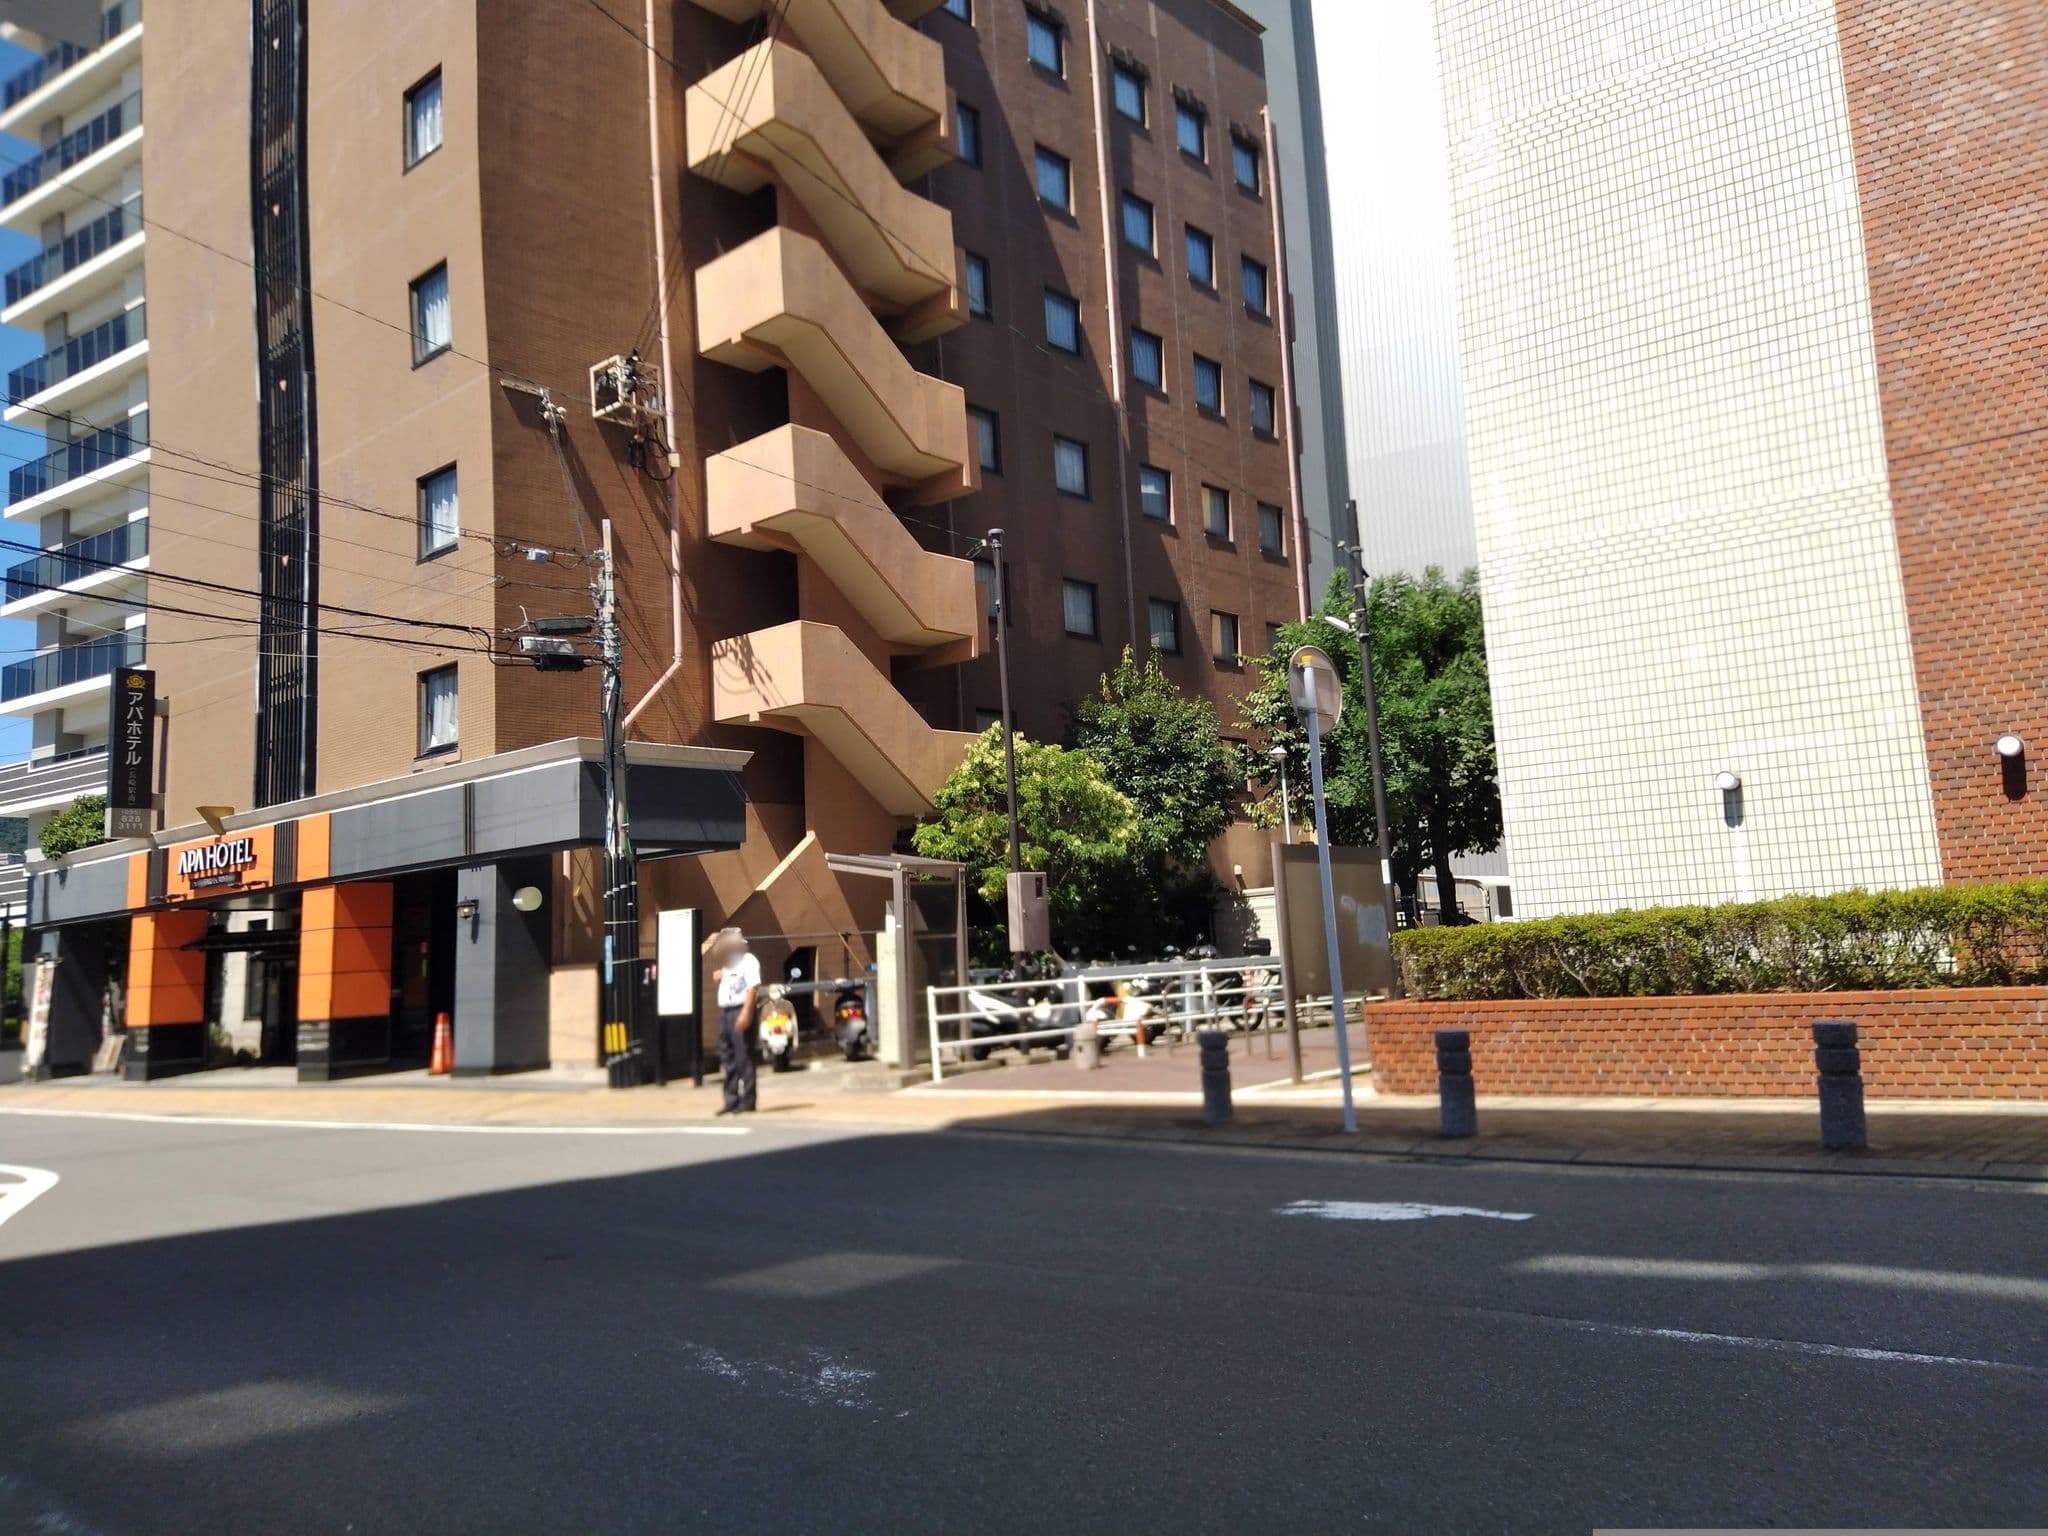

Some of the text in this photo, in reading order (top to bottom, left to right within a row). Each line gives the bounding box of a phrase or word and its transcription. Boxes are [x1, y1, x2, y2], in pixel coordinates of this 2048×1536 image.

[125, 692, 144, 766] アパホテル
[178, 838, 253, 875] APA HOTEL
